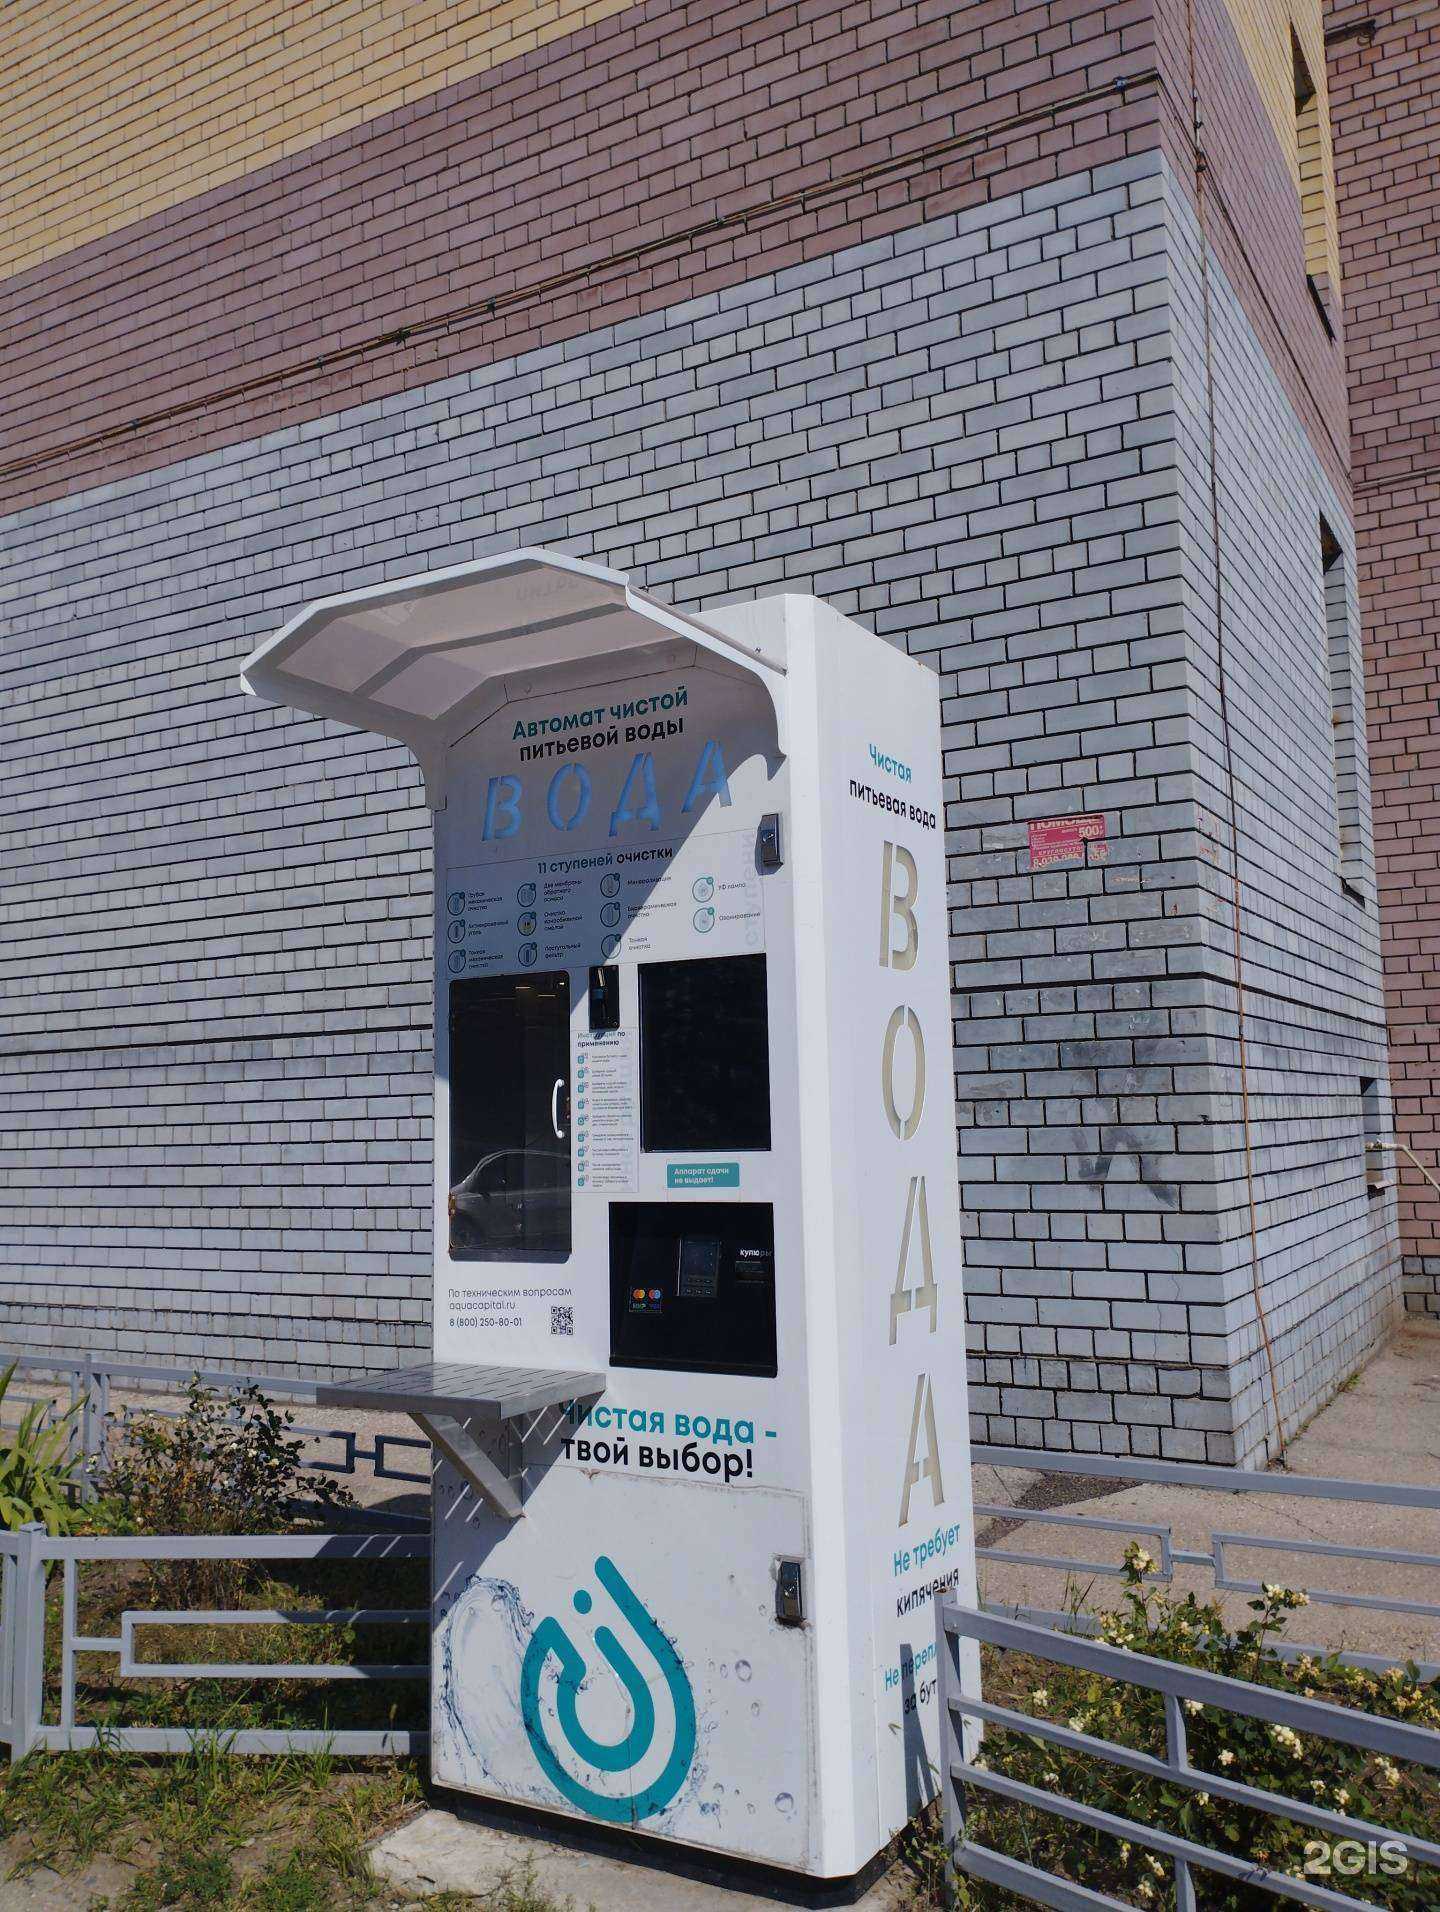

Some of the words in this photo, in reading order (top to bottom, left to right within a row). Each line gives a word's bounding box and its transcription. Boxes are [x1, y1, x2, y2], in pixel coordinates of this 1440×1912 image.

[512, 708, 605, 740] Автомат
[610, 686, 688, 720] чистой
[519, 726, 619, 762] питьевой
[625, 718, 684, 742] воды
[869, 743, 912, 783] Чистая
[482, 739, 732, 841] ВОДА
[849, 779, 907, 818] питьевая
[909, 804, 936, 830] вода
[537, 862, 547, 874] 11
[549, 853, 613, 874] ступеней
[616, 848, 673, 864] очистки
[706, 1167, 729, 1176] сдачи
[879, 839, 945, 1528] ВОДА
[448, 1288, 460, 1298] По
[462, 1288, 520, 1298] техническим
[522, 1288, 572, 1299] вопросам
[449, 1302, 516, 1312] aquacapital.ru
[449, 1318, 455, 1327] 8
[456, 1317, 478, 1328] (800)
[480, 1317, 522, 1327] 250-80-01
[558, 1399, 665, 1434] Чистая
[675, 1413, 754, 1446] вода
[560, 1436, 629, 1466] твой
[639, 1442, 753, 1483] выбор!
[893, 1550, 911, 1577] Не
[912, 1523, 960, 1568] требует
[885, 1667, 899, 1692] Не
[901, 1643, 937, 1681] переп
[904, 1694, 917, 1715] за
